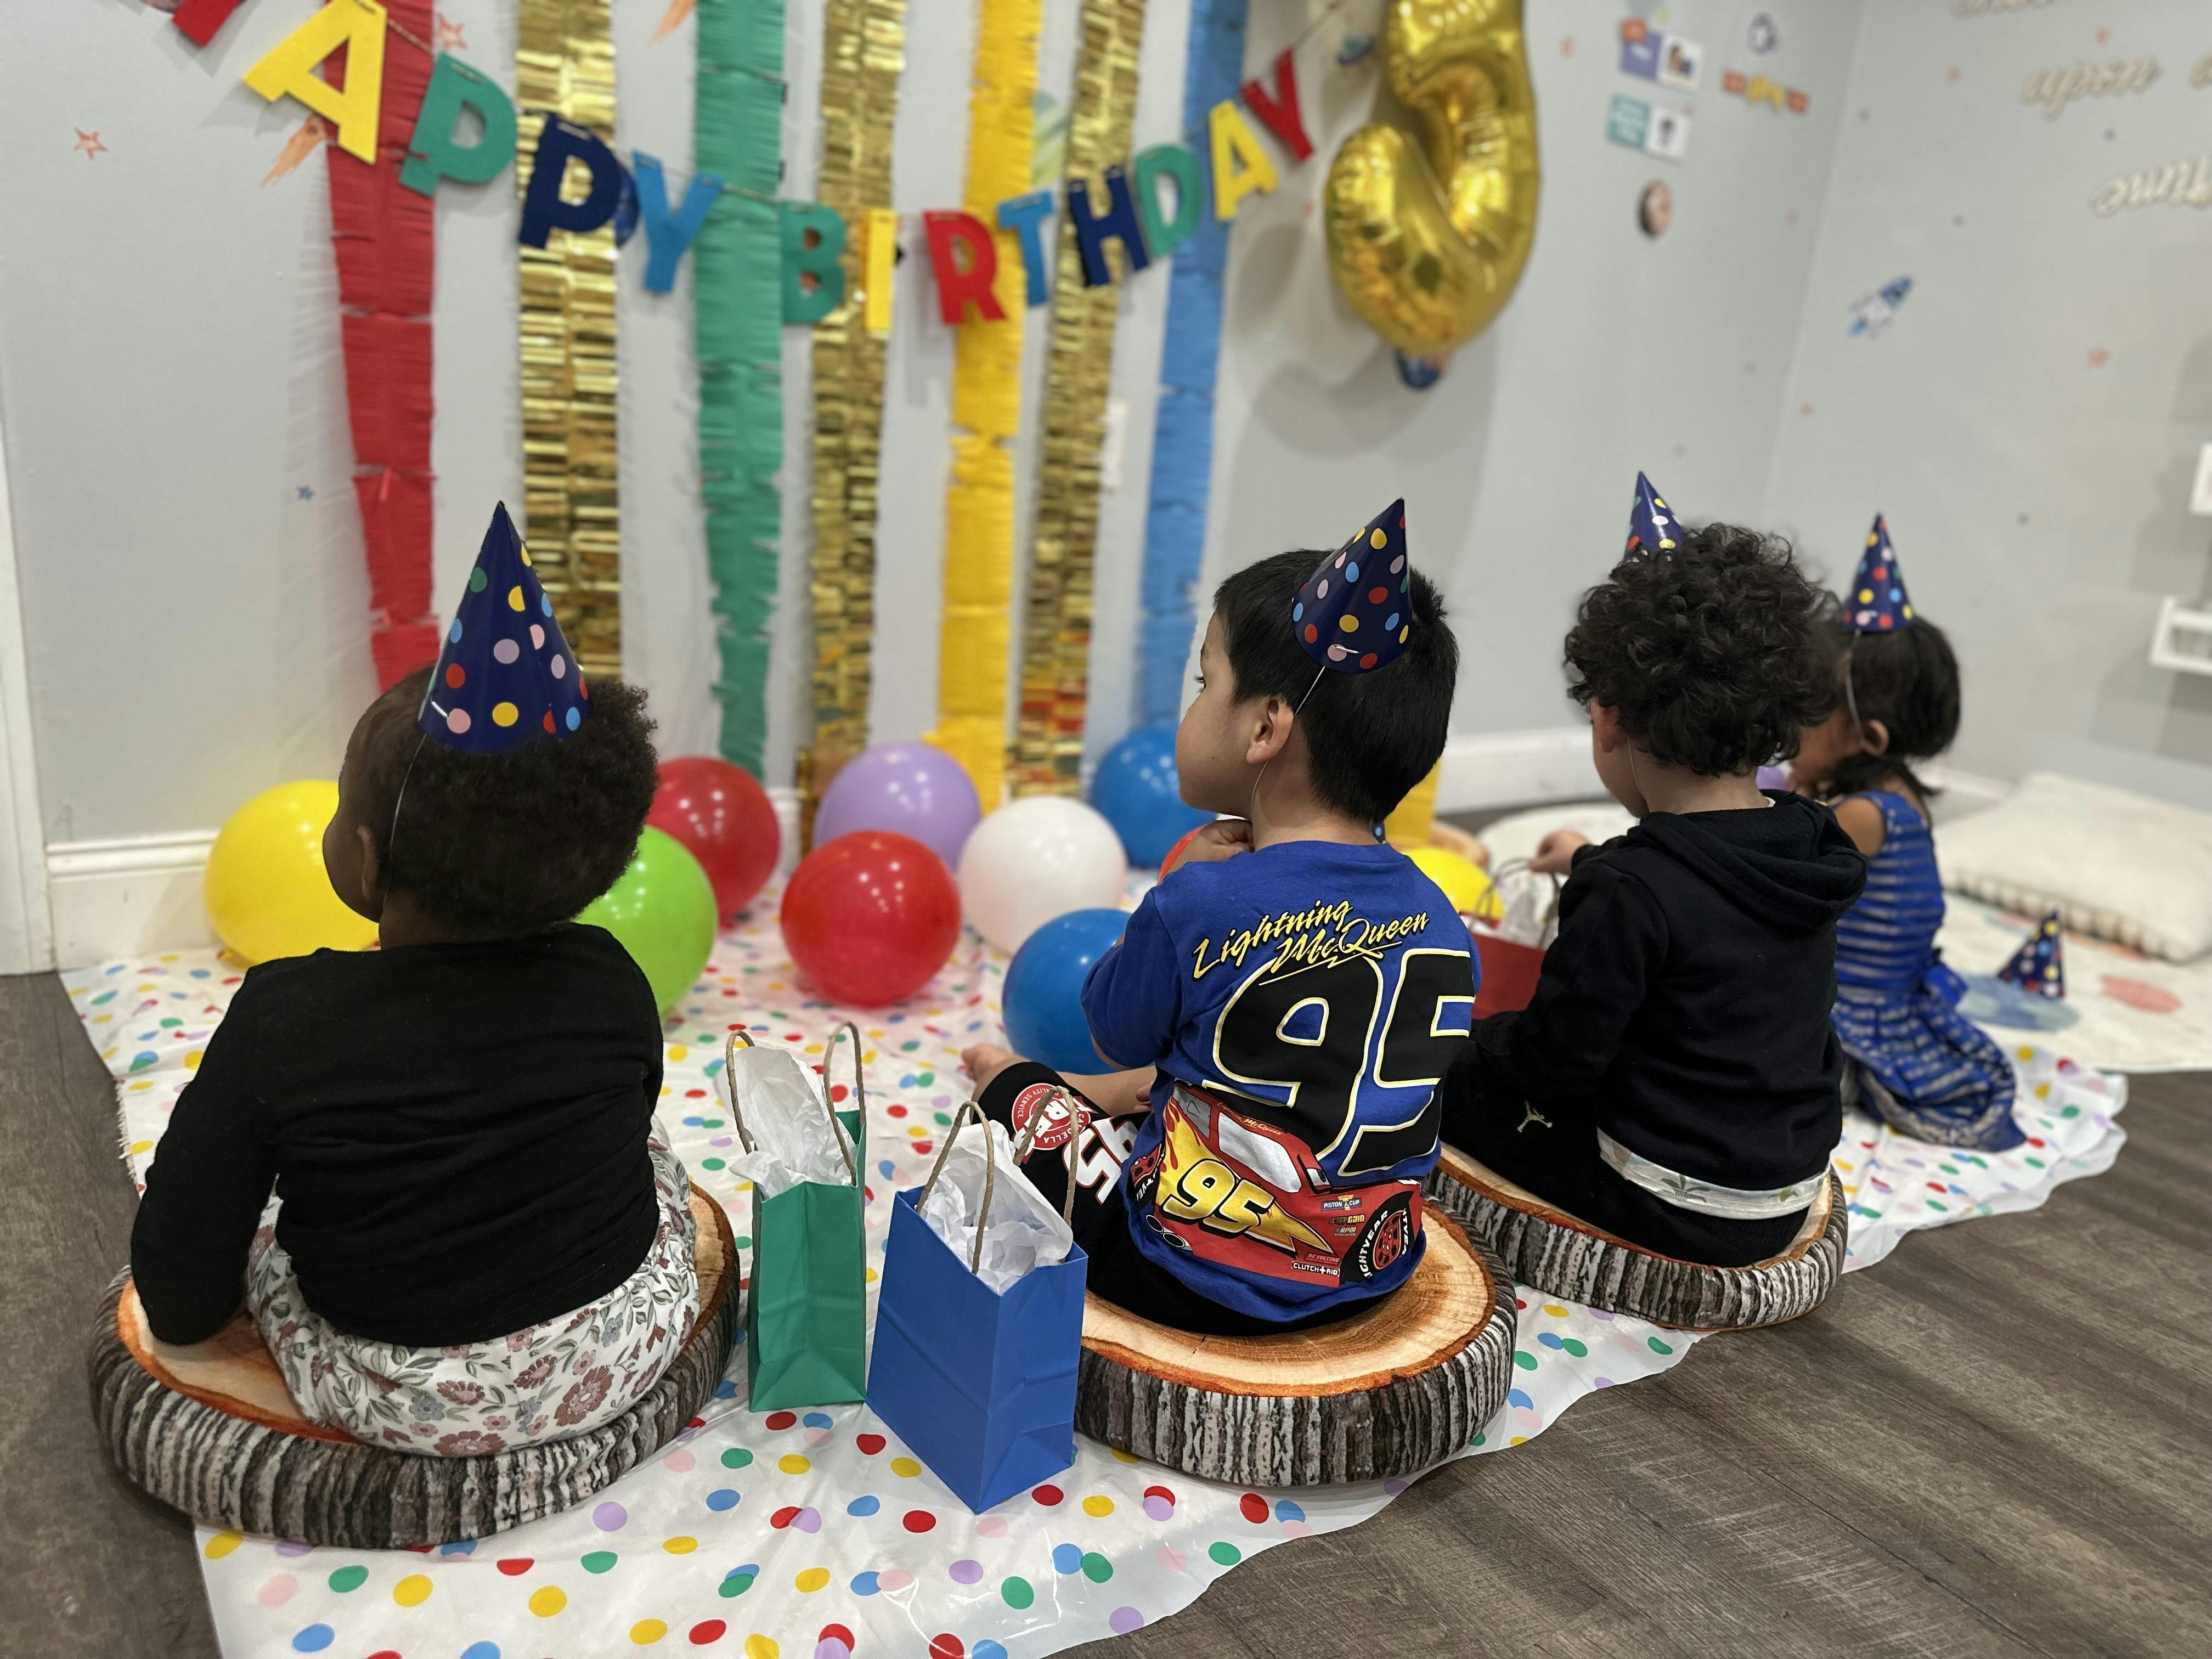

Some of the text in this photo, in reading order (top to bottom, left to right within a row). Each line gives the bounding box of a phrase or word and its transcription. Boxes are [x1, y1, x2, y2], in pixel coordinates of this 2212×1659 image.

[172, 0, 1314, 332] APPY BIRTHDAY
[1193, 900, 1353, 980] Lightning
[1269, 911, 1430, 974] McQueen
[1201, 947, 1476, 1177] 95
[1017, 1093, 1032, 1119] SERVICE
[1159, 1158, 1277, 1237] 95
[1358, 1210, 1388, 1278] IGHTYEAR
